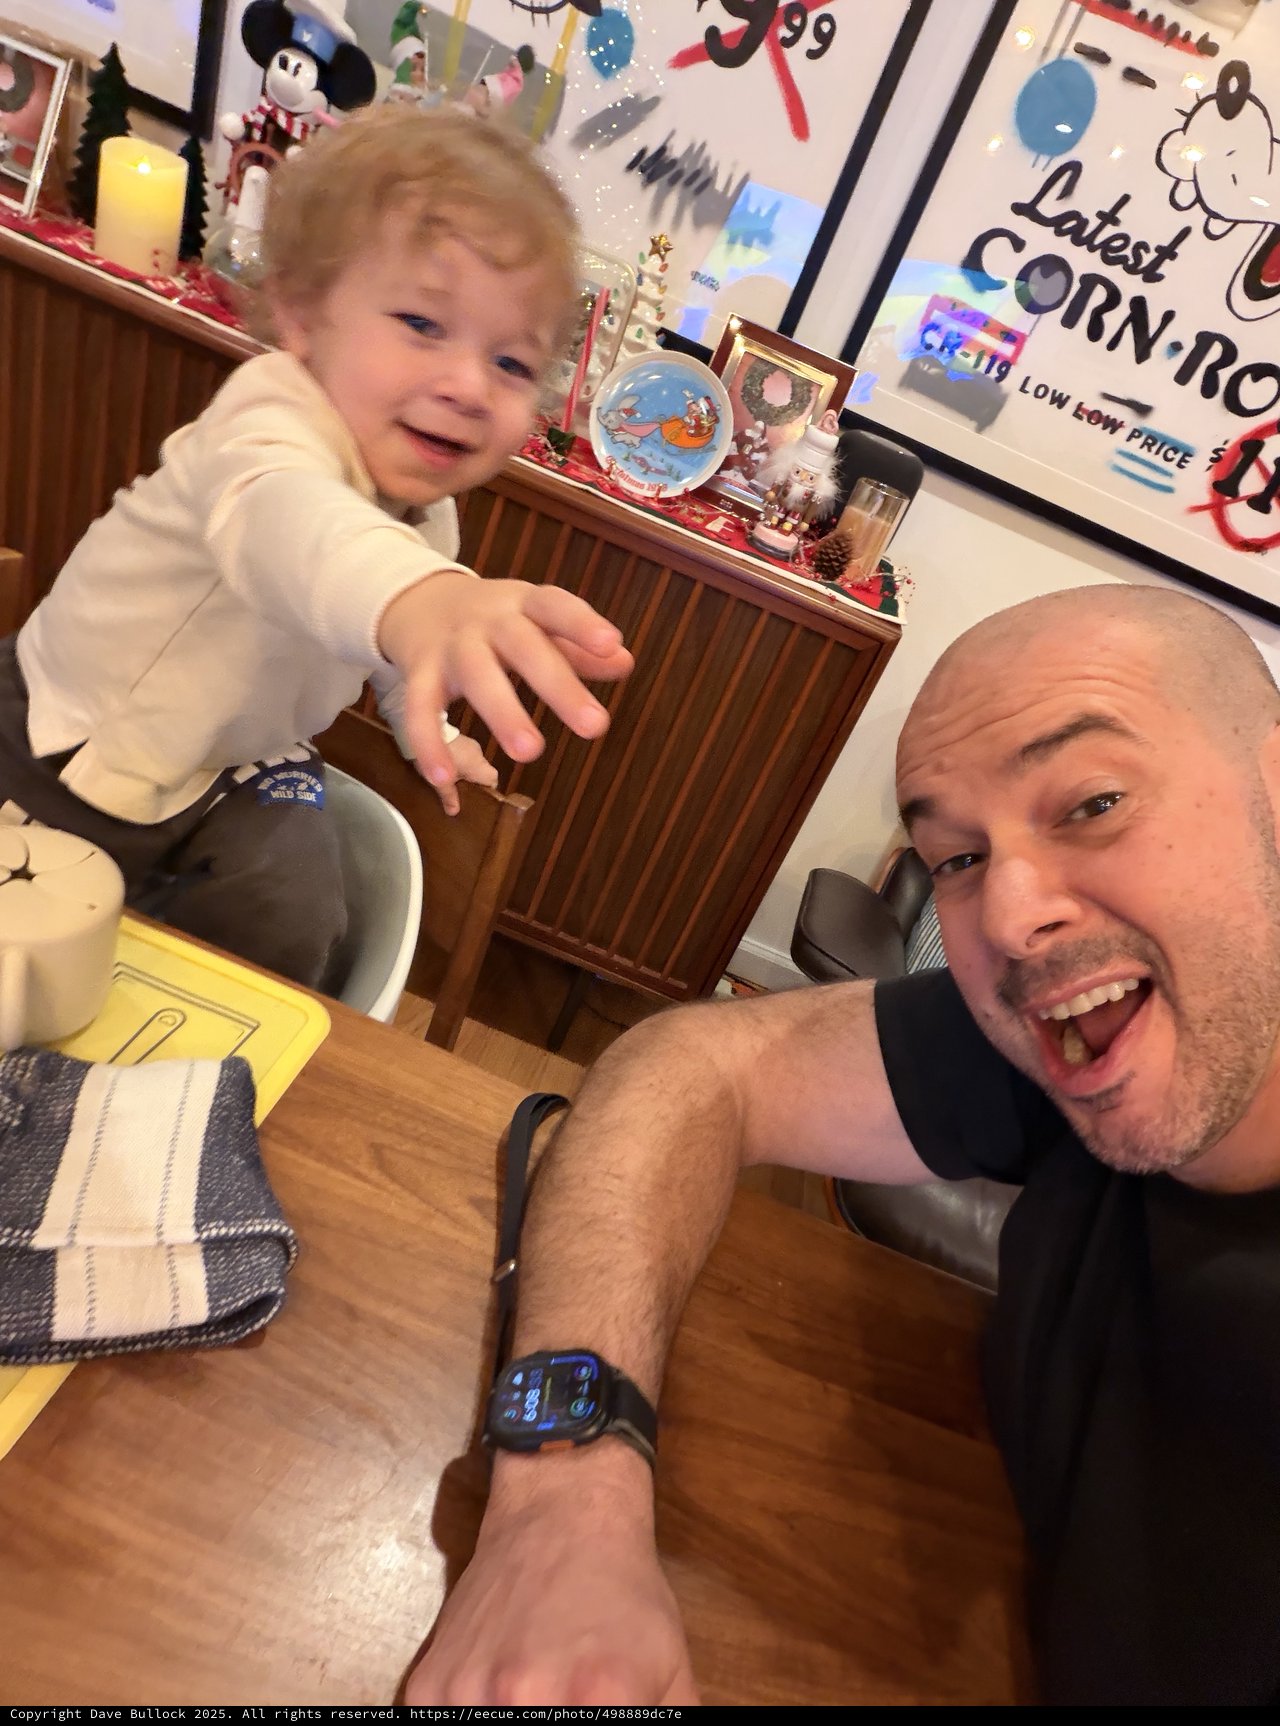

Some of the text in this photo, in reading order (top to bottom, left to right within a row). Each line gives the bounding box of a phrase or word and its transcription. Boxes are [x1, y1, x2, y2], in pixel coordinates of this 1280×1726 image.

[1010, 160, 1191, 283] Latest
[1019, 375, 1072, 410] LOW
[1073, 401, 1124, 435] LOW
[1126, 428, 1194, 469] PRICE
[270, 790, 316, 802] WILD SIDE
